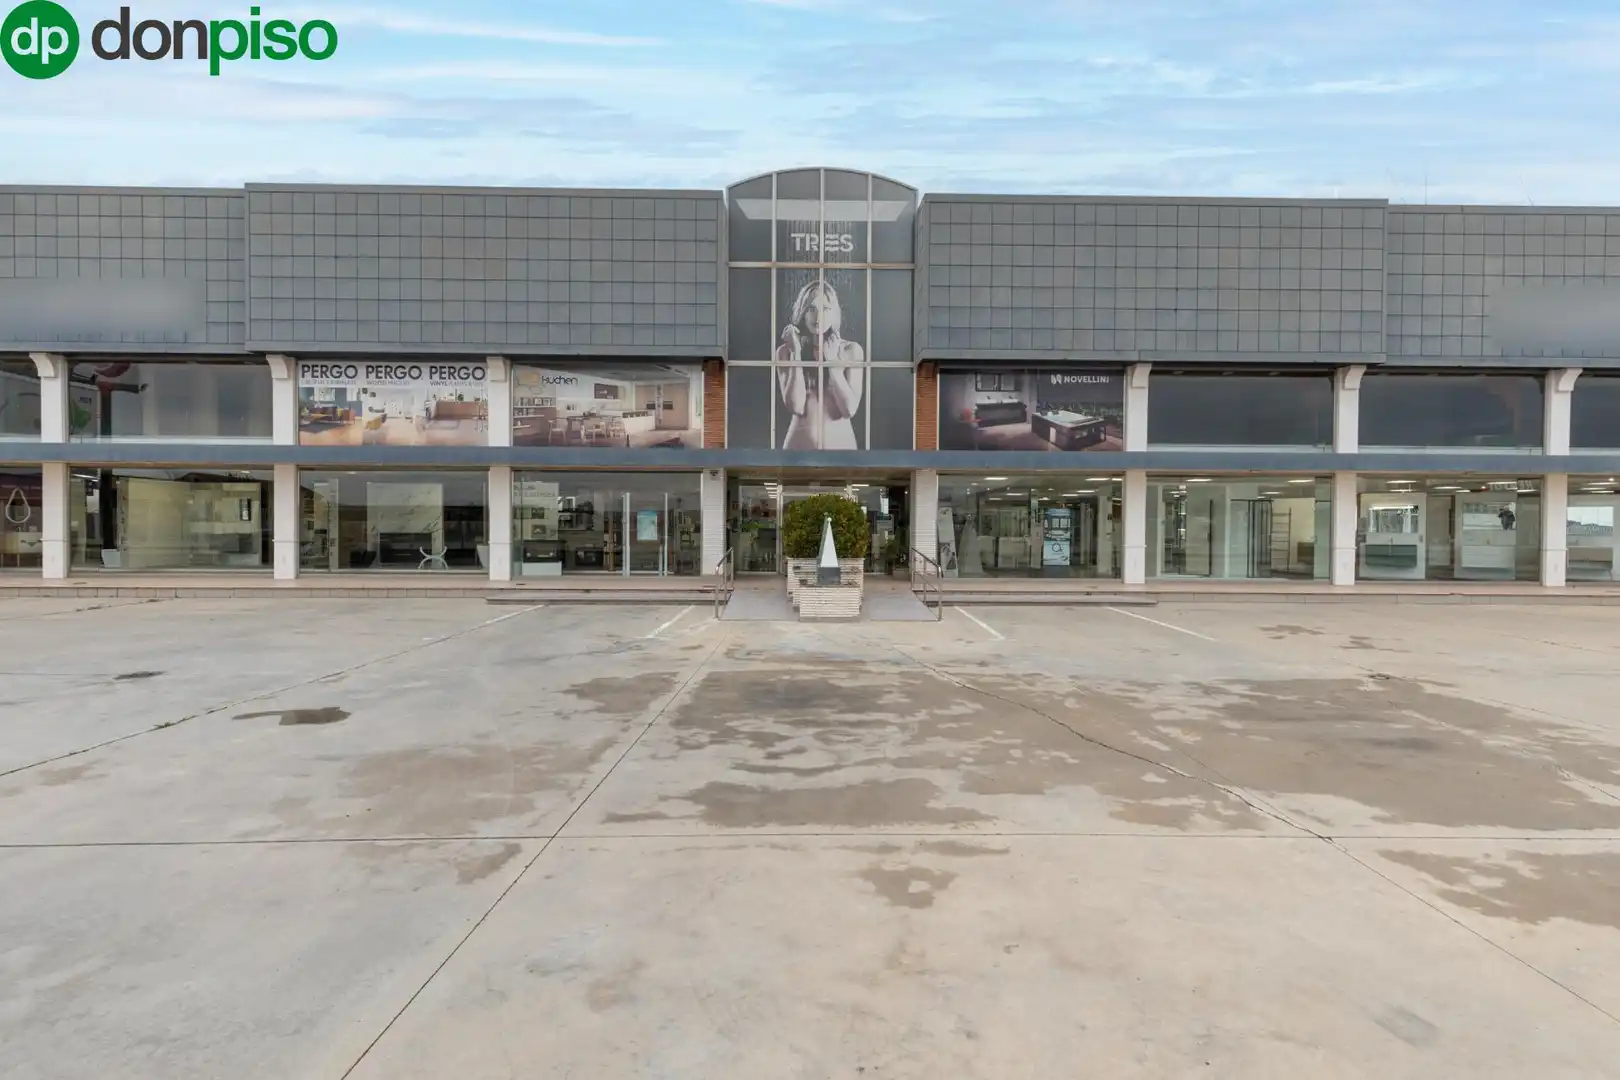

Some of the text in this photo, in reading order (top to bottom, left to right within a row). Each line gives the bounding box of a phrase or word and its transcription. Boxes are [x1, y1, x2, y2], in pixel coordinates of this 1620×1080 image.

[790, 232, 854, 252] TRES
[301, 364, 358, 379] PERGO
[365, 365, 422, 380] PERGO
[429, 366, 486, 381] PERGO
[1063, 375, 1110, 383] NOVELLINI
